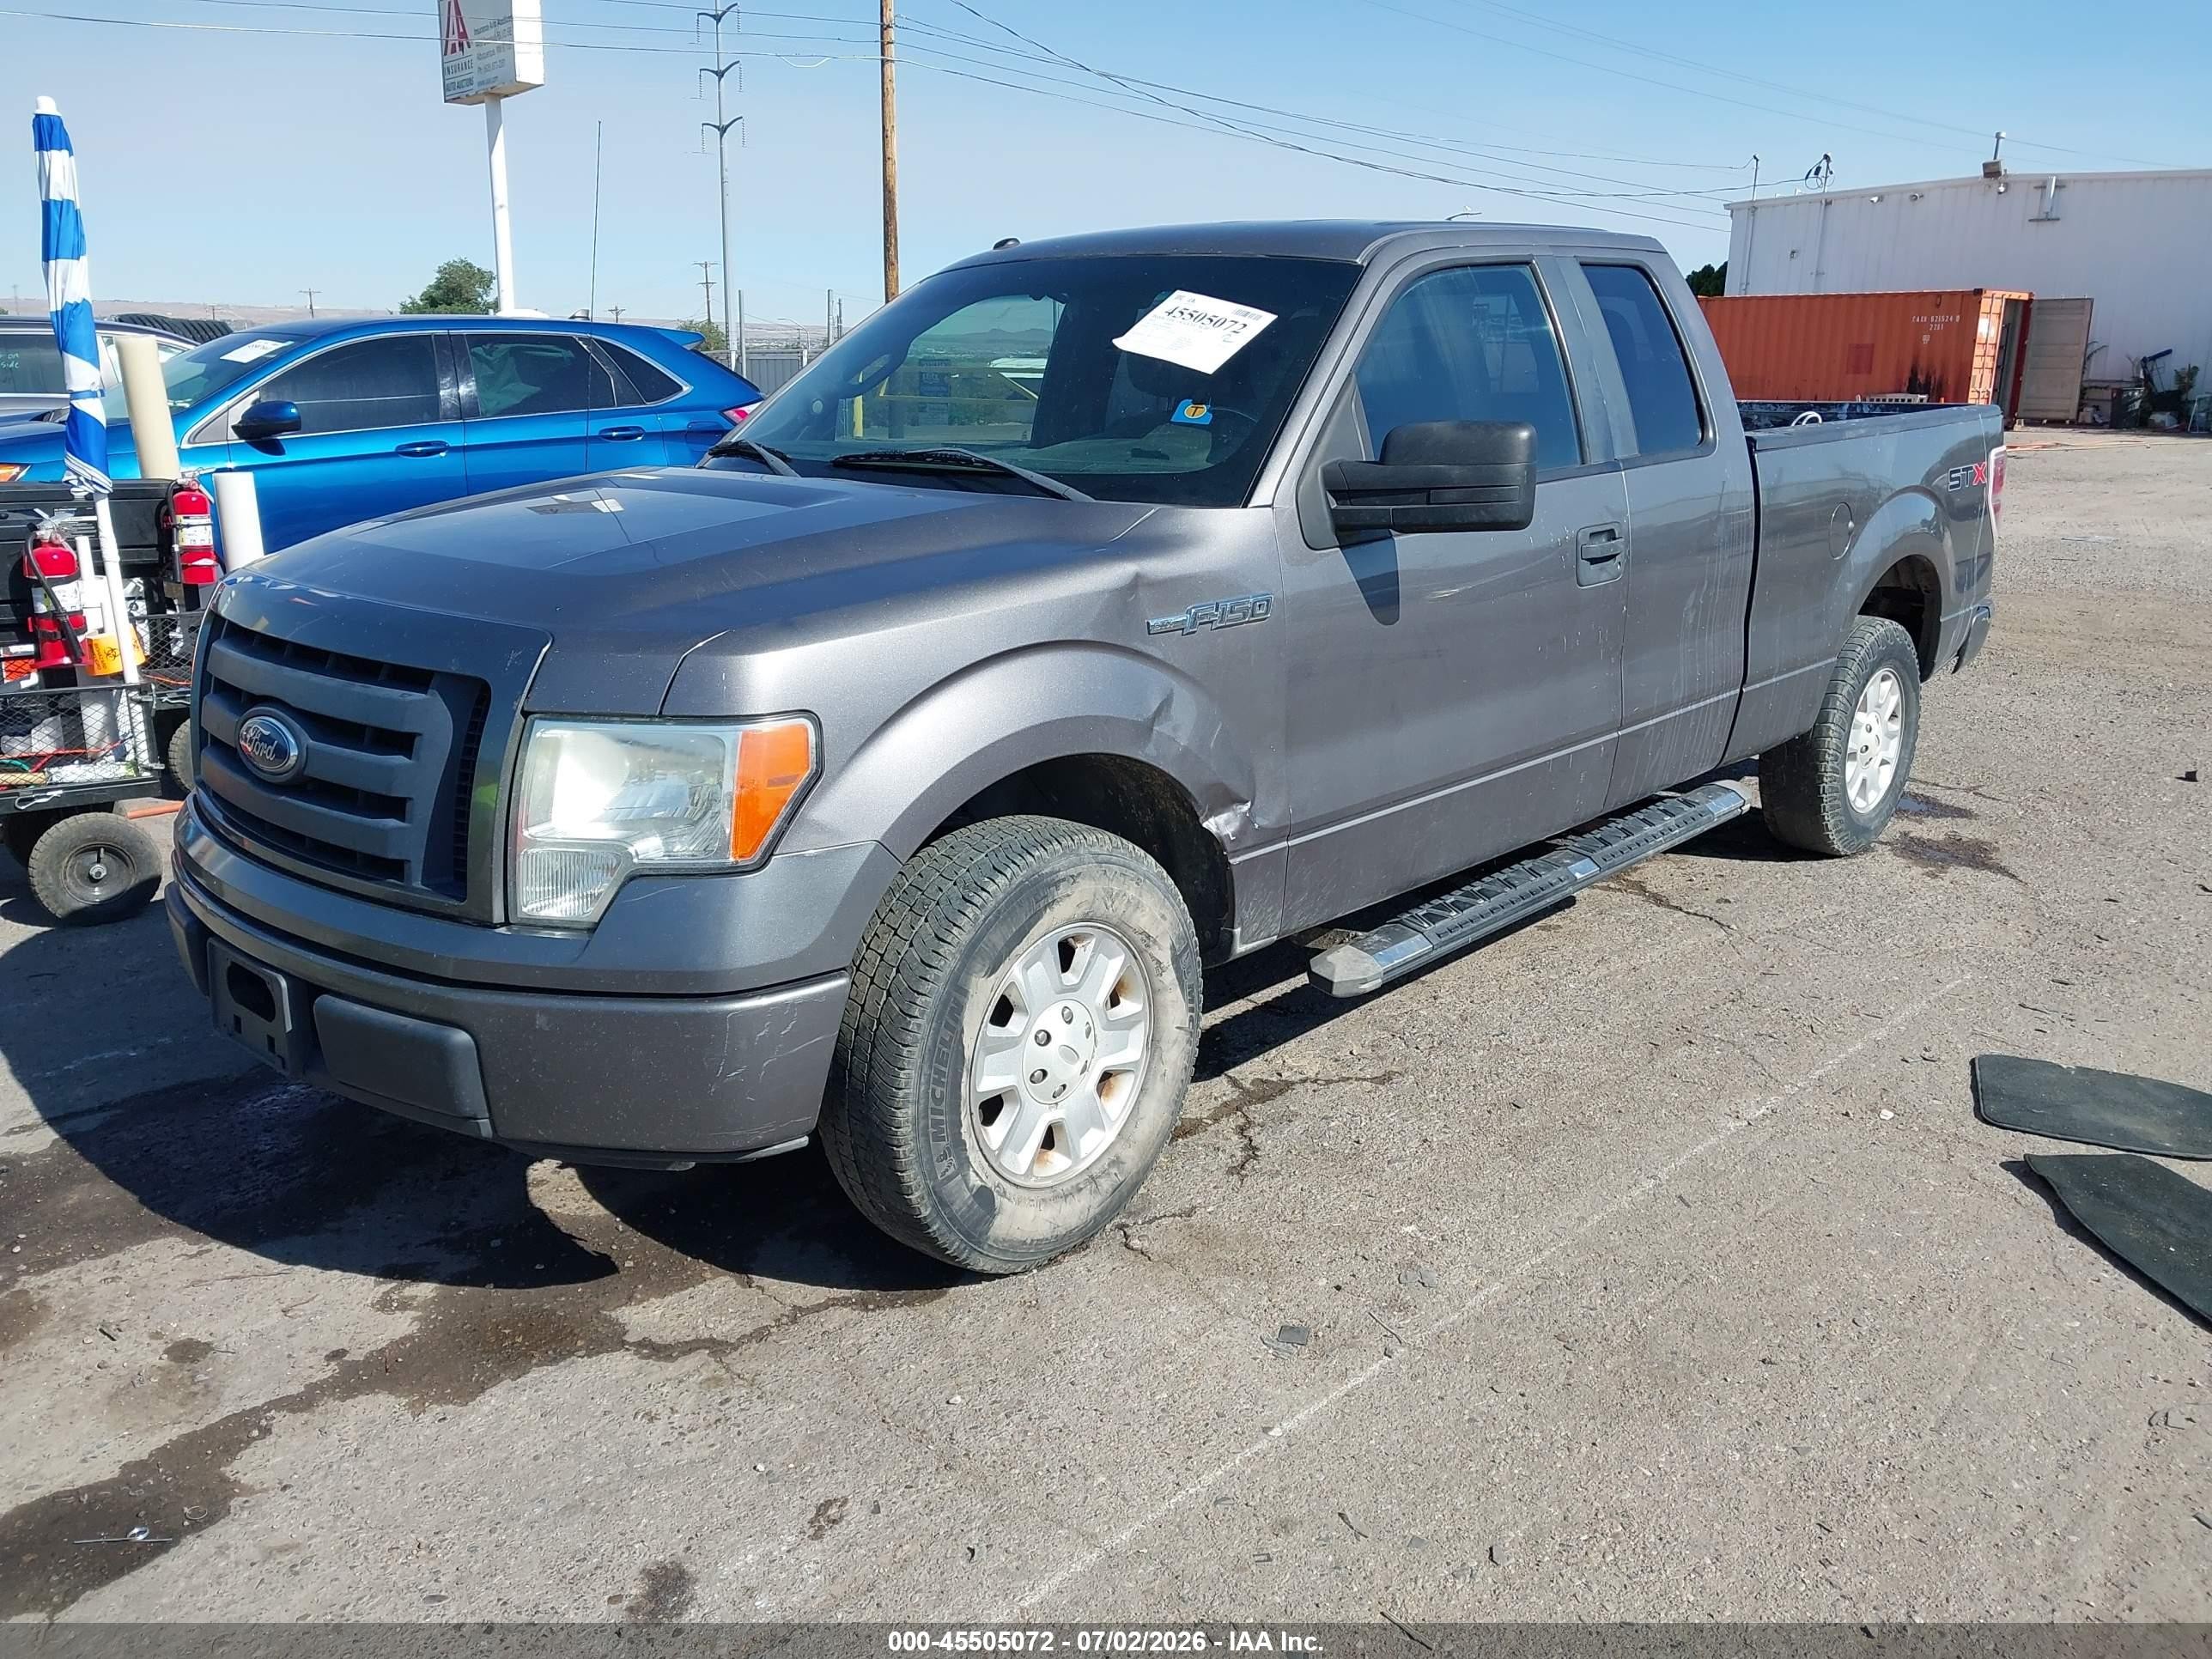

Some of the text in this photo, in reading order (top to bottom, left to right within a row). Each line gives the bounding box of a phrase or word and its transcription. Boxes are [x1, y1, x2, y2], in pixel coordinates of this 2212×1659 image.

[444, 59, 474, 76] INSURANCE
[1164, 306, 1248, 334] 45505072
[1948, 462, 1987, 491] STX
[1182, 592, 1274, 636] F-150
[246, 724, 278, 761] Ford
[928, 996, 963, 1143] MICHELIN
